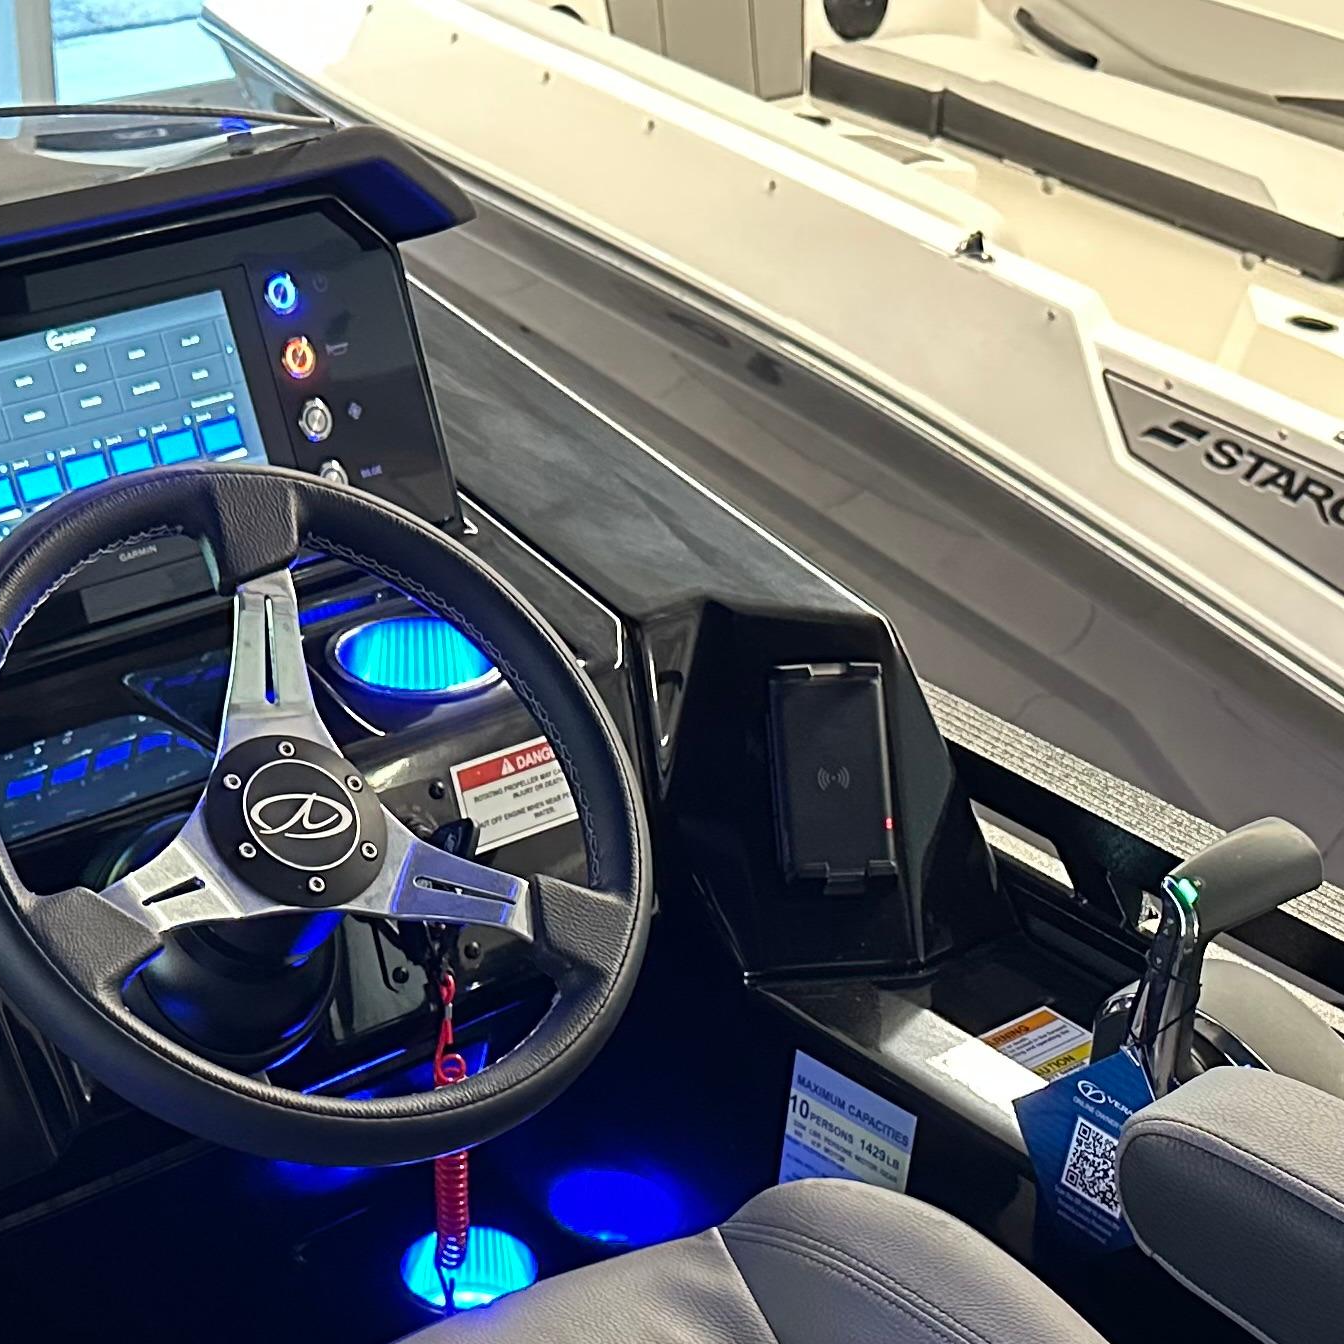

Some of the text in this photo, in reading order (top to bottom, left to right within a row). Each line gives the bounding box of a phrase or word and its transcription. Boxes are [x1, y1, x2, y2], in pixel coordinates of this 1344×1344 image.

[118, 545, 158, 562] GARMIN
[515, 746, 555, 769] DANG
[503, 775, 540, 793] PROPELLER
[512, 787, 534, 799] INJURY
[503, 808, 526, 821] ENGINE
[526, 801, 545, 812] WHEN
[789, 1094, 810, 1119] 10
[809, 1113, 854, 1145] PERSONS
[797, 1074, 909, 1148] MAXIMUM CAPACITIES
